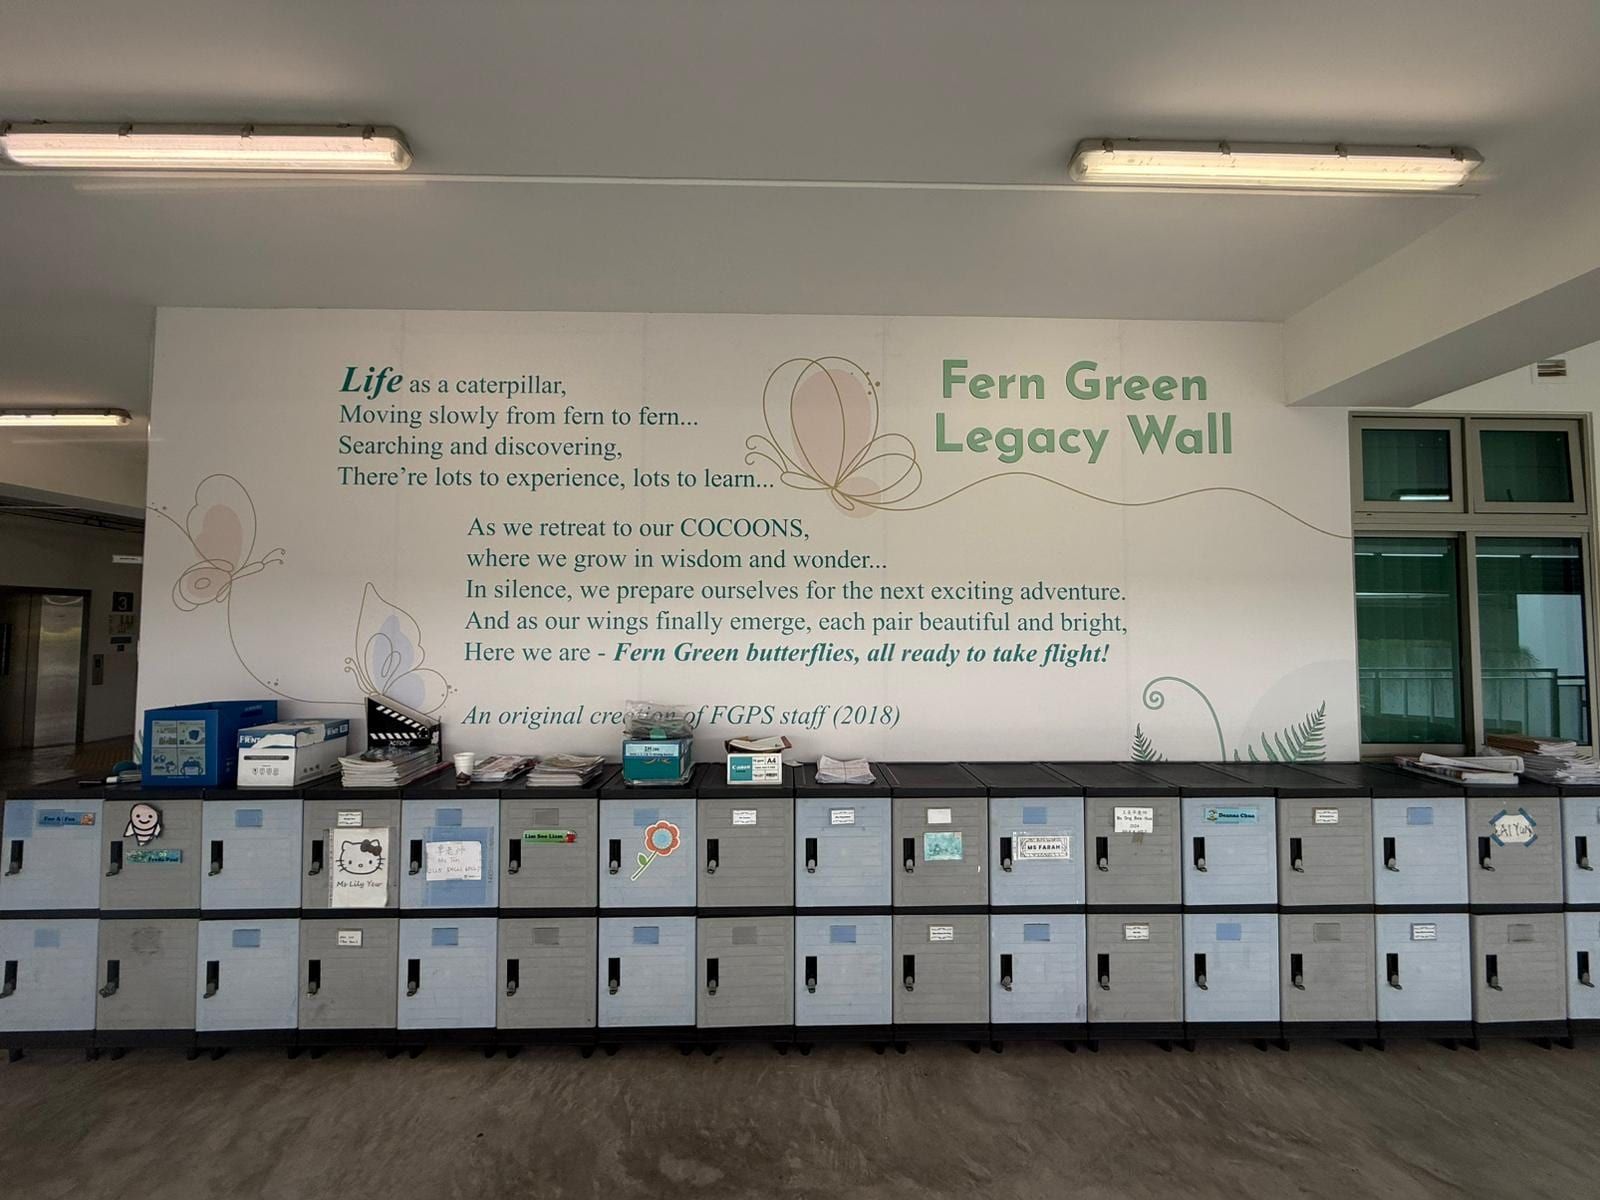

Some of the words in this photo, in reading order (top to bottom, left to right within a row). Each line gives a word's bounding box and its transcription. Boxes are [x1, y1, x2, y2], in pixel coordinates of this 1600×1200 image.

[338, 365, 403, 400] Life
[409, 380, 430, 393] as
[437, 380, 448, 393] a
[455, 375, 566, 399] caterpillar,
[942, 358, 1044, 399] Fern
[1065, 361, 1207, 401] Green
[338, 404, 422, 429] Moving
[429, 404, 497, 429] slowly
[505, 405, 556, 425] from
[563, 406, 604, 425] fern
[611, 409, 631, 425] to
[637, 406, 698, 425] fern...
[338, 435, 443, 460] Searching
[449, 436, 488, 455] and
[494, 436, 622, 461] discovering,
[935, 411, 1109, 464] Legacy
[1126, 412, 1232, 455] Wall
[434, 467, 472, 488] lots
[479, 470, 499, 486] to
[506, 467, 626, 493] experience,
[633, 468, 670, 487] lots
[676, 471, 696, 488] to
[703, 468, 773, 488] learn...
[466, 517, 495, 536] As
[502, 523, 533, 536] we
[538, 520, 606, 536] retreat
[611, 520, 632, 536] to
[639, 520, 674, 536] our
[679, 518, 809, 541] COCOONS,
[466, 548, 530, 567] where
[536, 554, 567, 567] we
[572, 554, 627, 572] grow
[634, 549, 654, 567] in
[660, 549, 743, 568] wisdom
[748, 549, 786, 568] and
[792, 549, 887, 568] wonder...
[118, 596, 127, 610] 3
[465, 579, 487, 598] In
[493, 579, 572, 601] silence,
[579, 586, 610, 598] we
[615, 585, 694, 604] prepare
[700, 580, 798, 599] ourselves
[805, 580, 836, 599] for
[841, 580, 873, 599] the
[879, 584, 925, 600] next
[930, 581, 1014, 605] exciting
[1020, 581, 1125, 600] adventure.
[464, 610, 509, 629] And
[516, 616, 538, 631] as
[544, 616, 580, 630] our
[585, 611, 648, 635] wings
[655, 611, 724, 635] finally
[729, 617, 811, 635] emerge,
[818, 611, 866, 630] each
[871, 612, 913, 636] pair
[918, 612, 1010, 631] beautiful
[1016, 612, 1054, 632] and
[1059, 612, 1127, 636] bright,
[463, 642, 515, 662] Here
[521, 648, 552, 661] we
[558, 648, 591, 661] are
[611, 643, 665, 662] Fern
[673, 642, 739, 662] Green
[745, 643, 859, 667] butterflies,
[866, 643, 896, 662] all
[900, 643, 960, 667] ready
[965, 646, 986, 662] to
[992, 643, 1038, 662] take
[1038, 643, 1110, 668] flight!
[461, 704, 491, 724] An
[499, 704, 585, 730] original
[683, 705, 709, 730] of
[710, 704, 775, 725] FGPS
[780, 704, 833, 730] staff
[832, 704, 902, 730] (2018)
